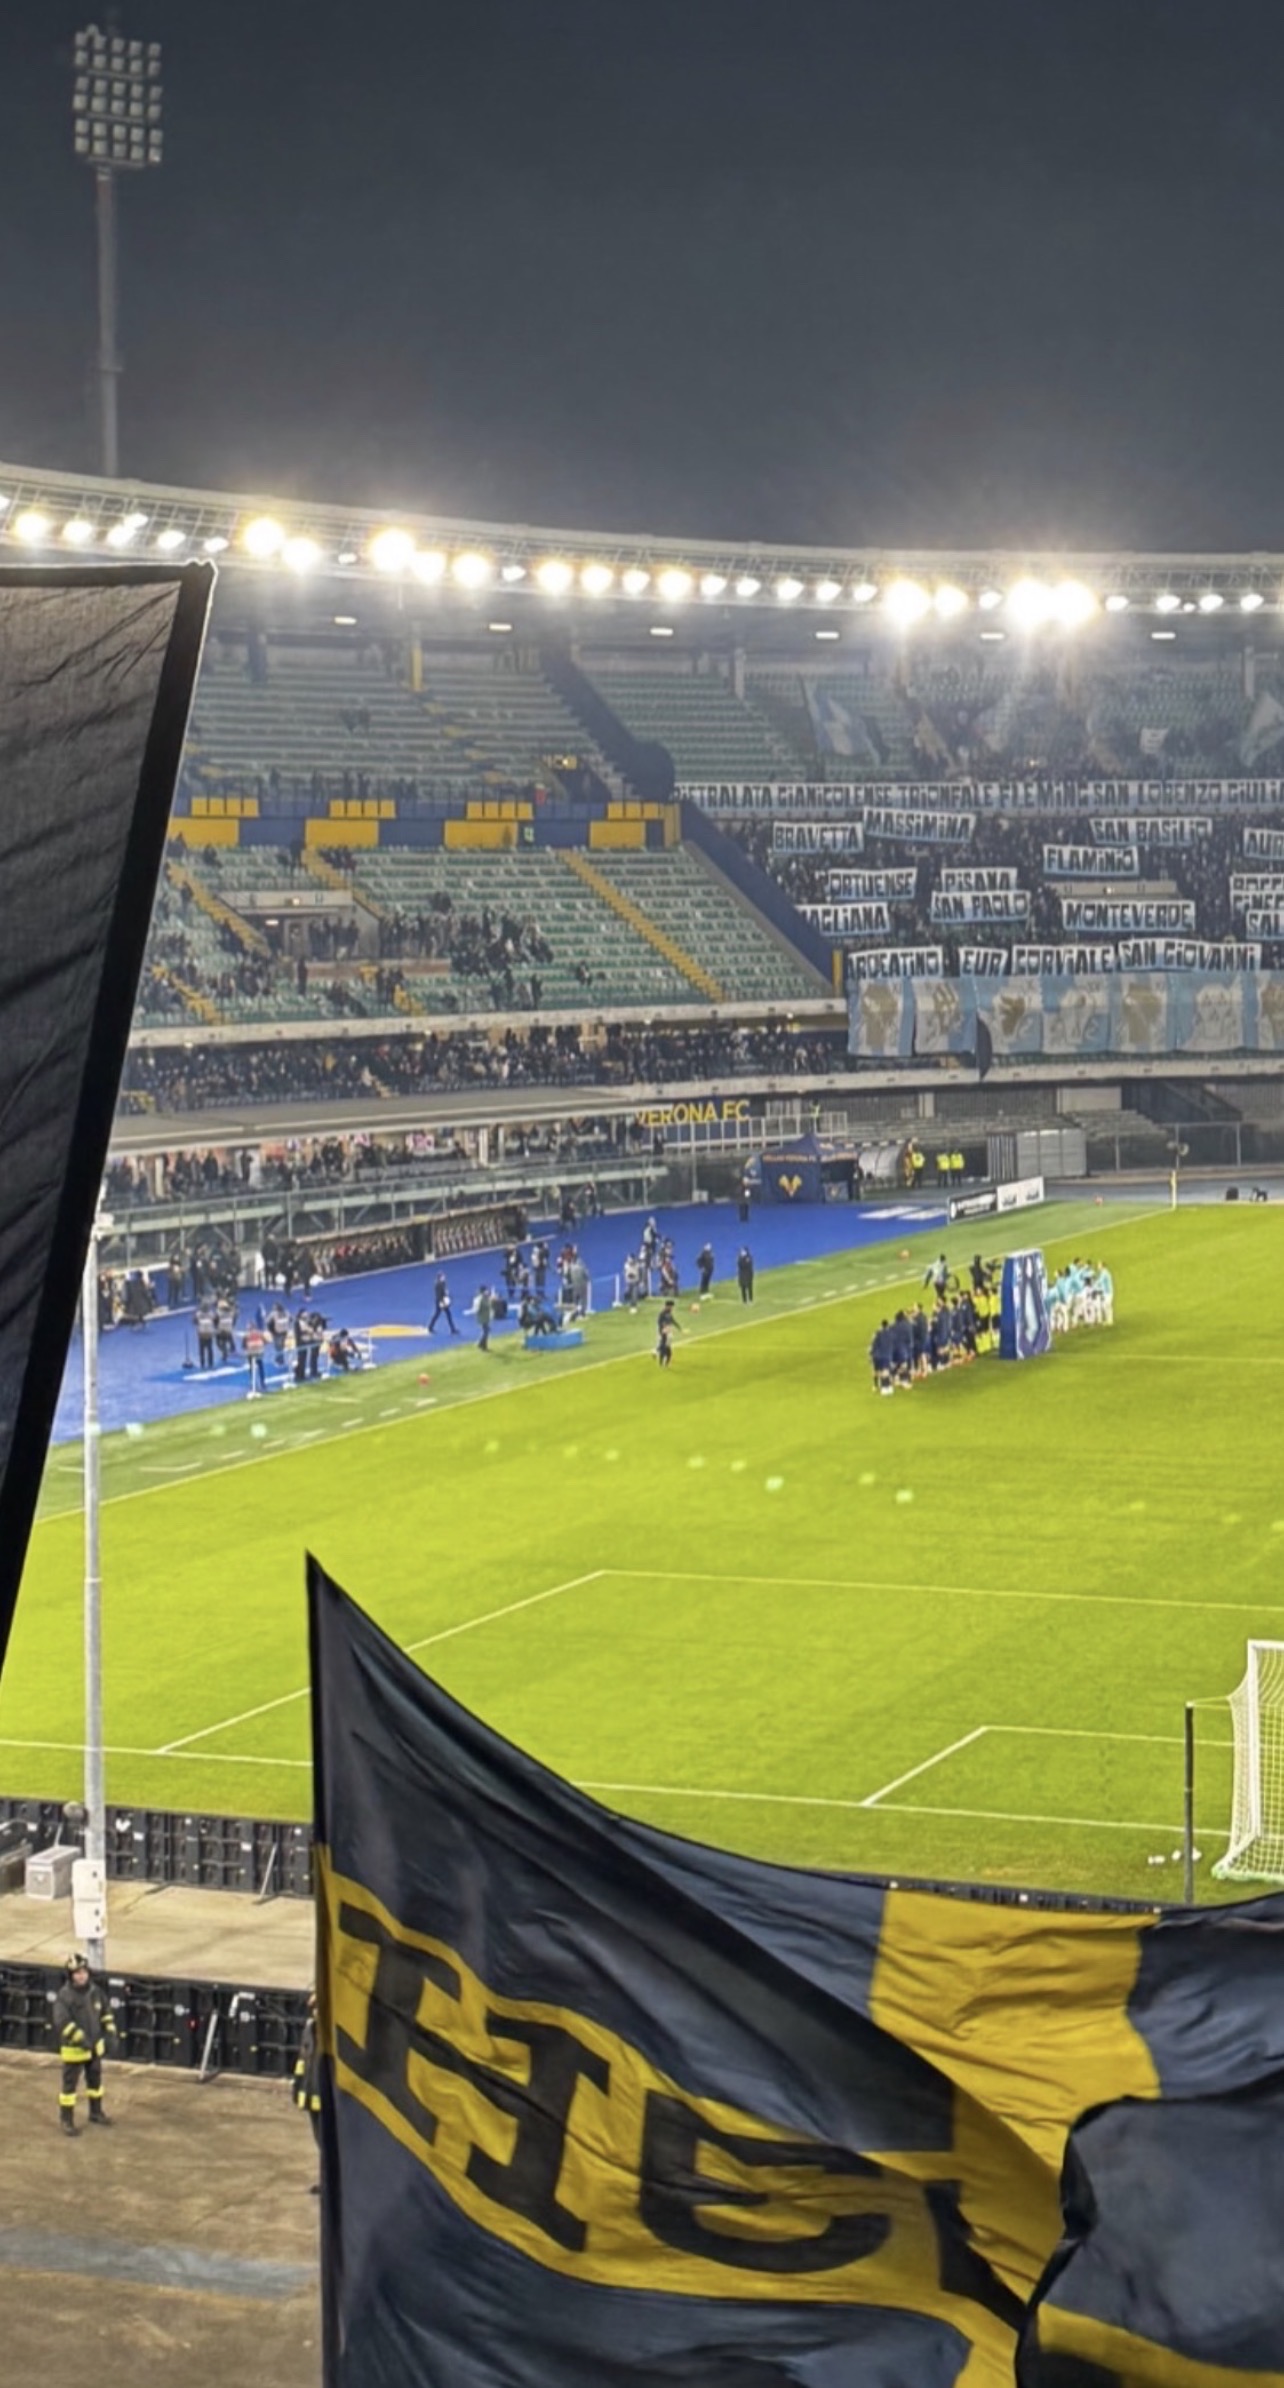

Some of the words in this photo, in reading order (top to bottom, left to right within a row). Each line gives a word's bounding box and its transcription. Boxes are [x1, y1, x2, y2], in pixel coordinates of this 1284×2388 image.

[1093, 782, 1129, 807] SAN
[775, 825, 860, 850] BRAVETTA
[1095, 820, 1129, 842] SAN
[933, 894, 965, 919] SAN
[971, 893, 1029, 918] PAOLO
[1066, 901, 1193, 929] MONTEVERDE
[961, 950, 1004, 977] EUR
[1120, 941, 1156, 970] SAN
[637, 1101, 718, 1127] VERONA
[722, 1099, 751, 1122] FC
